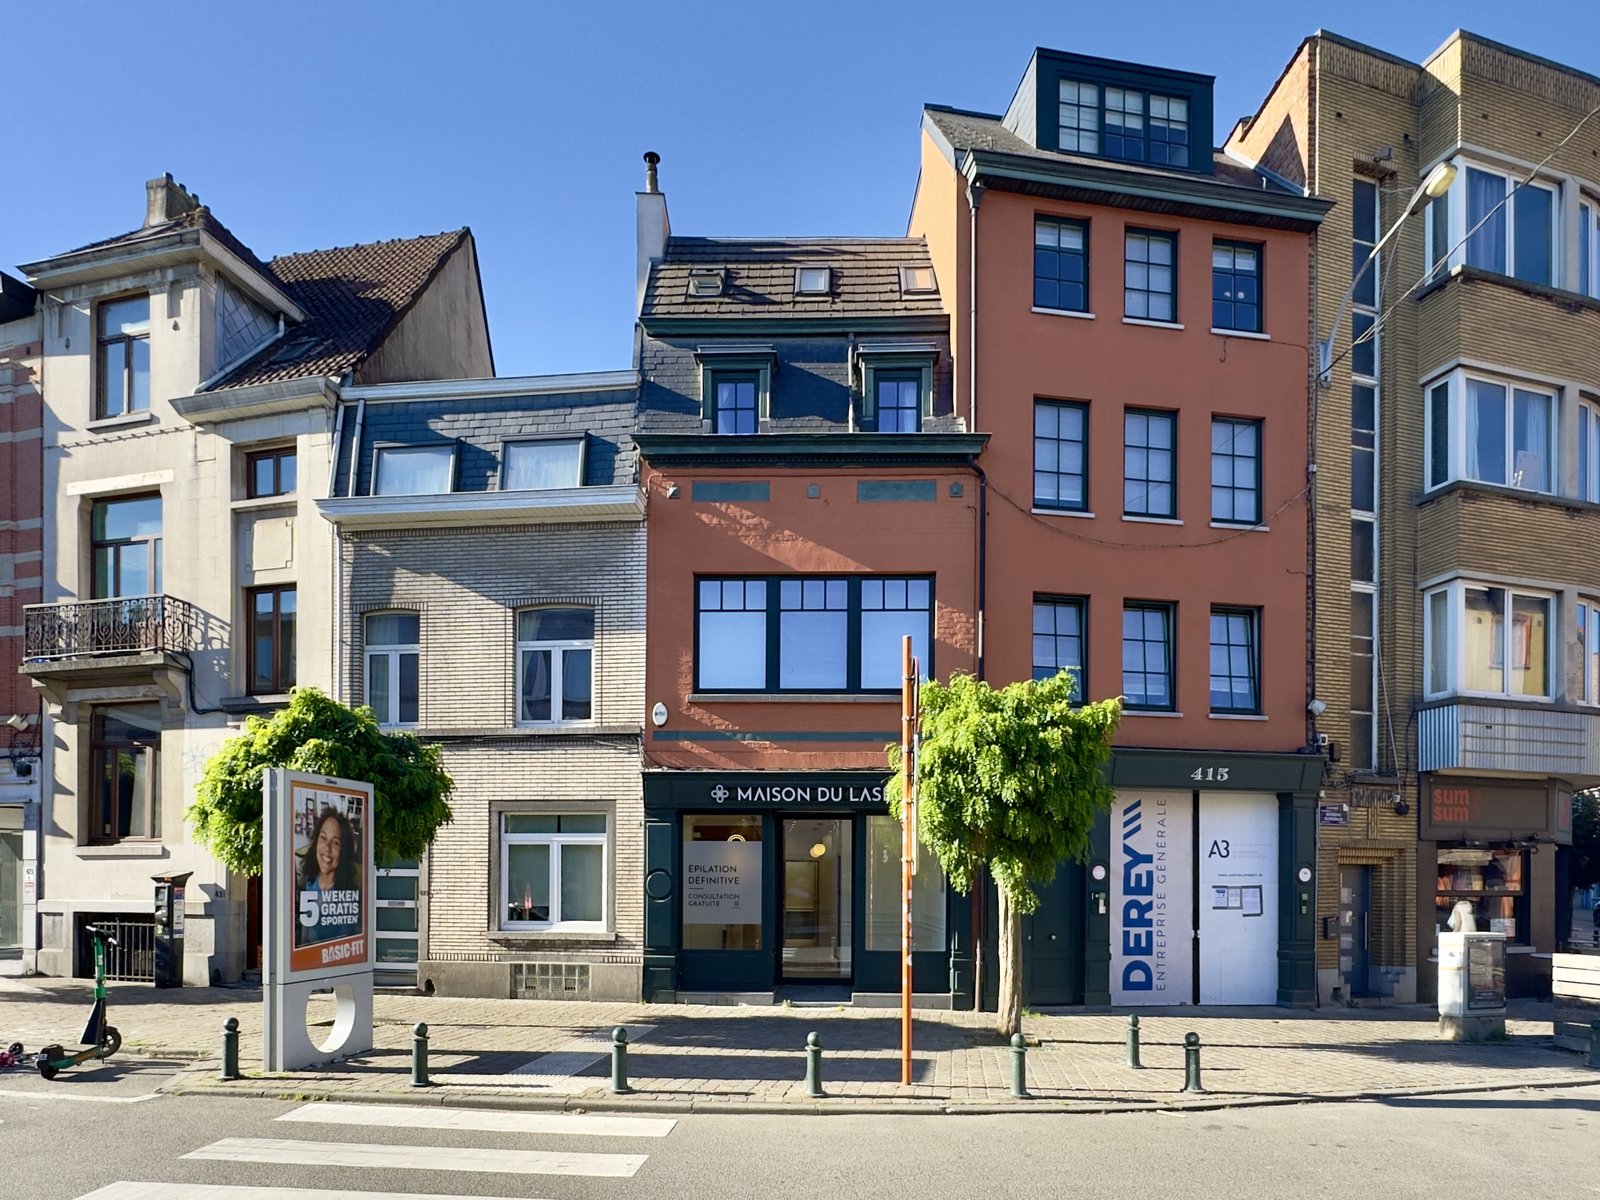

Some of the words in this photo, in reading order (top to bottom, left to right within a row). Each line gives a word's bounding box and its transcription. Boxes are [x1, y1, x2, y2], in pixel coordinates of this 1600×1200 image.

[1190, 767, 1229, 781] 415
[737, 786, 810, 802] MAISON
[818, 786, 842, 802] DU
[1433, 788, 1470, 805] sum
[1433, 805, 1469, 822] sum
[1156, 799, 1167, 884] GÉNÉRALE
[1208, 840, 1230, 858] A3
[688, 863, 737, 873] ÉPILATION
[688, 875, 740, 885] DÉFINITIVE
[321, 890, 359, 902] WEKEN
[299, 890, 320, 928] 5
[321, 902, 359, 915] GRATIS
[1122, 842, 1153, 991] DEREY
[1156, 892, 1167, 991] ENTREPRISE
[322, 940, 364, 964] BASIC-FIT
